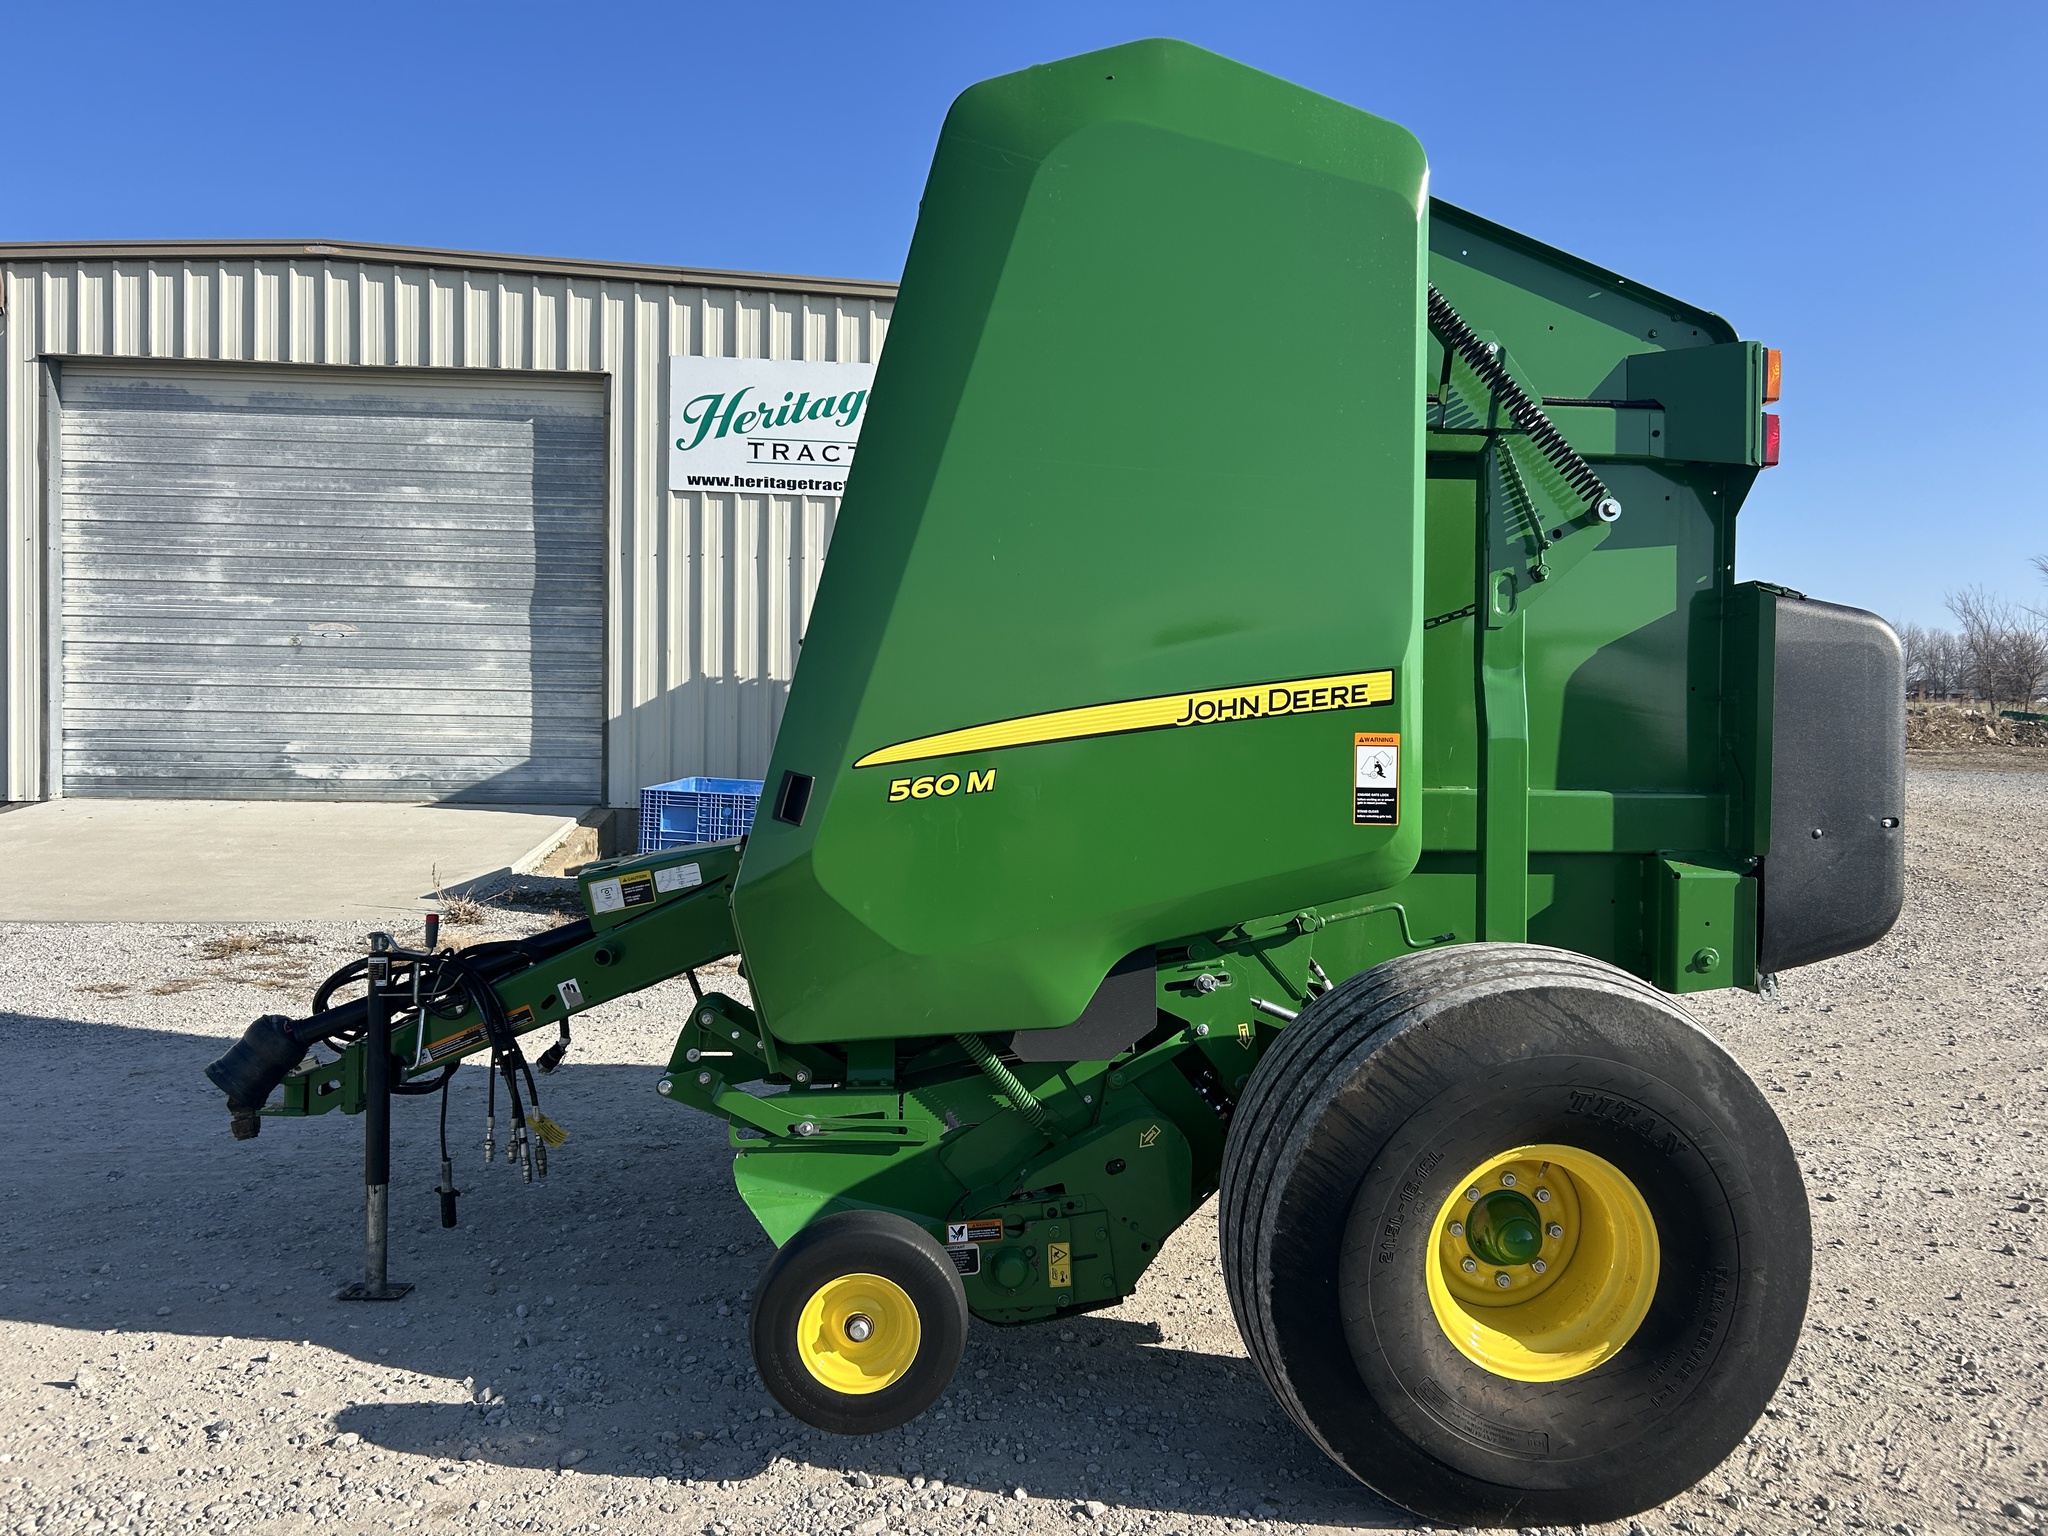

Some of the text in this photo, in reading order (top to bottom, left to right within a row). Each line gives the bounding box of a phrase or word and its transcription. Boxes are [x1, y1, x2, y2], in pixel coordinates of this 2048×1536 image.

[1176, 684, 1369, 723] JOHN DEERE
[887, 767, 998, 802] 560 M
[1564, 1090, 1690, 1157] TITAN
